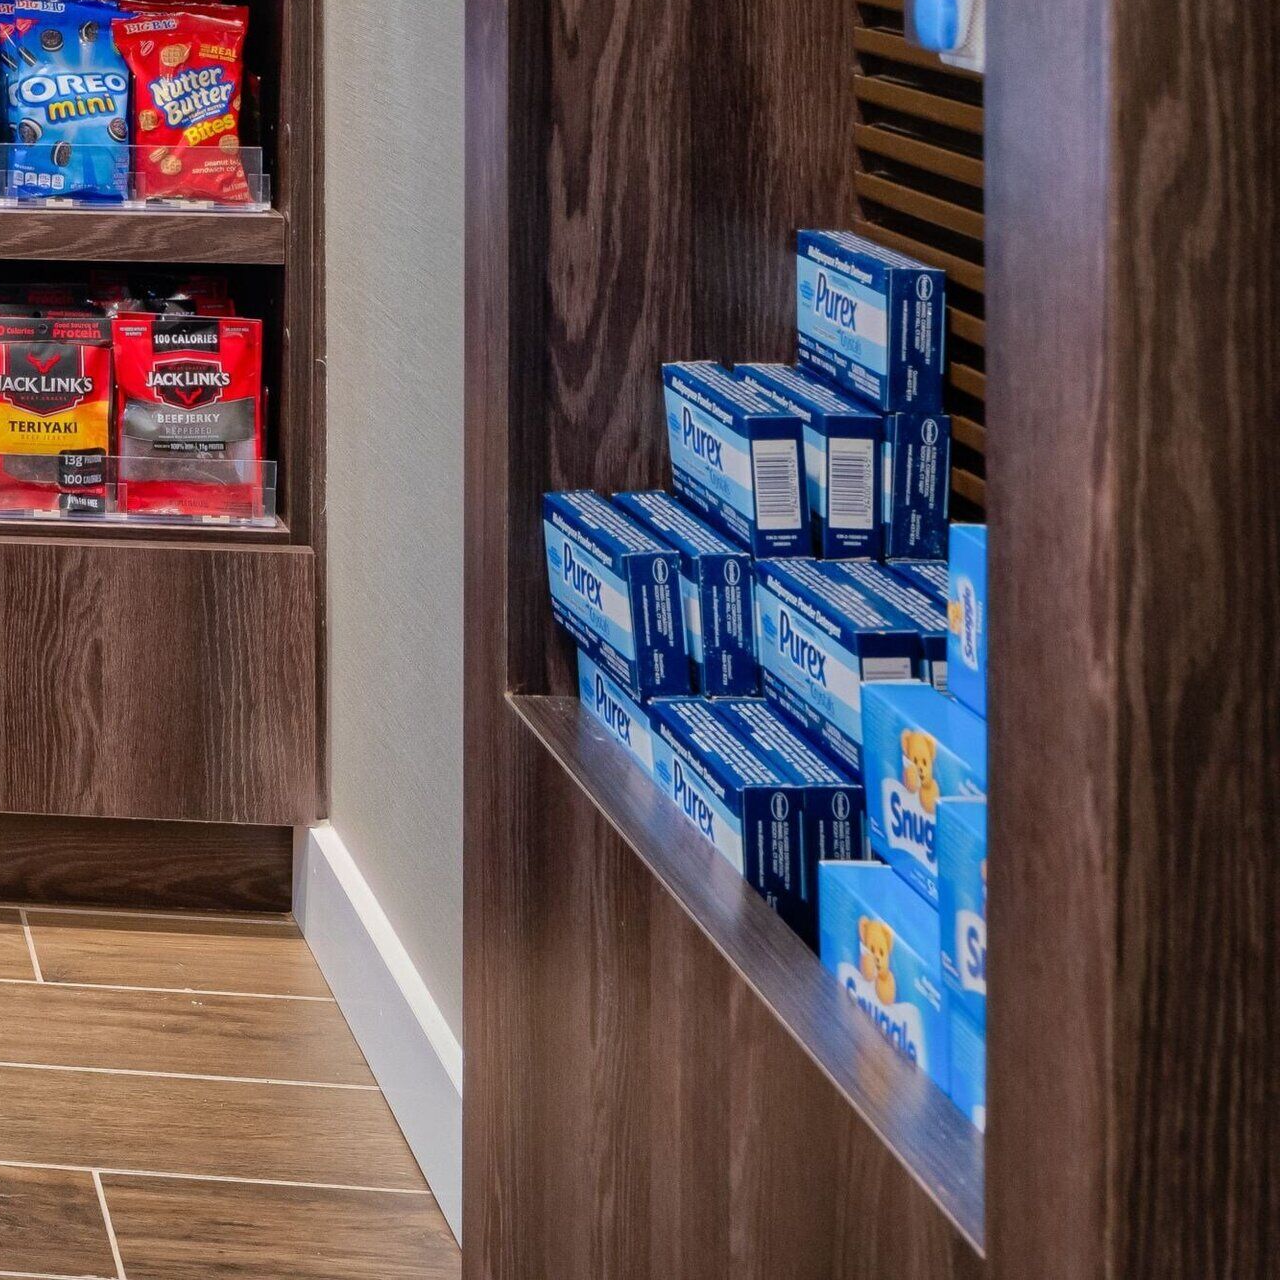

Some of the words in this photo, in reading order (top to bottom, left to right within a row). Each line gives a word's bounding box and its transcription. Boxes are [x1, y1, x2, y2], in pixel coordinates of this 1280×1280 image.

[126, 21, 151, 34] BIG
[151, 19, 177, 33] BAG
[210, 43, 237, 57] REAL
[19, 73, 127, 100] OREO
[151, 66, 223, 106] Nutter
[47, 93, 116, 120] mini
[164, 82, 234, 125] Butter
[184, 113, 237, 145] Bites
[815, 272, 858, 332] Purex
[6, 326, 35, 336] Calories
[52, 327, 102, 338] Protein
[153, 334, 171, 344] 100
[171, 333, 218, 345] CALORIES
[40, 376, 94, 393] LINK'S
[145, 371, 184, 387] JACK
[184, 370, 231, 387] LINK'S
[8, 420, 78, 433] TERIYAKI
[157, 414, 182, 423] BEEF
[183, 413, 221, 424] JERKY
[683, 406, 724, 471] Purex
[63, 454, 83, 468] 13g
[63, 474, 83, 484] 100
[563, 541, 603, 611] Purex
[779, 609, 827, 688] Purex
[595, 673, 631, 747] Purex
[674, 758, 716, 843] Purex
